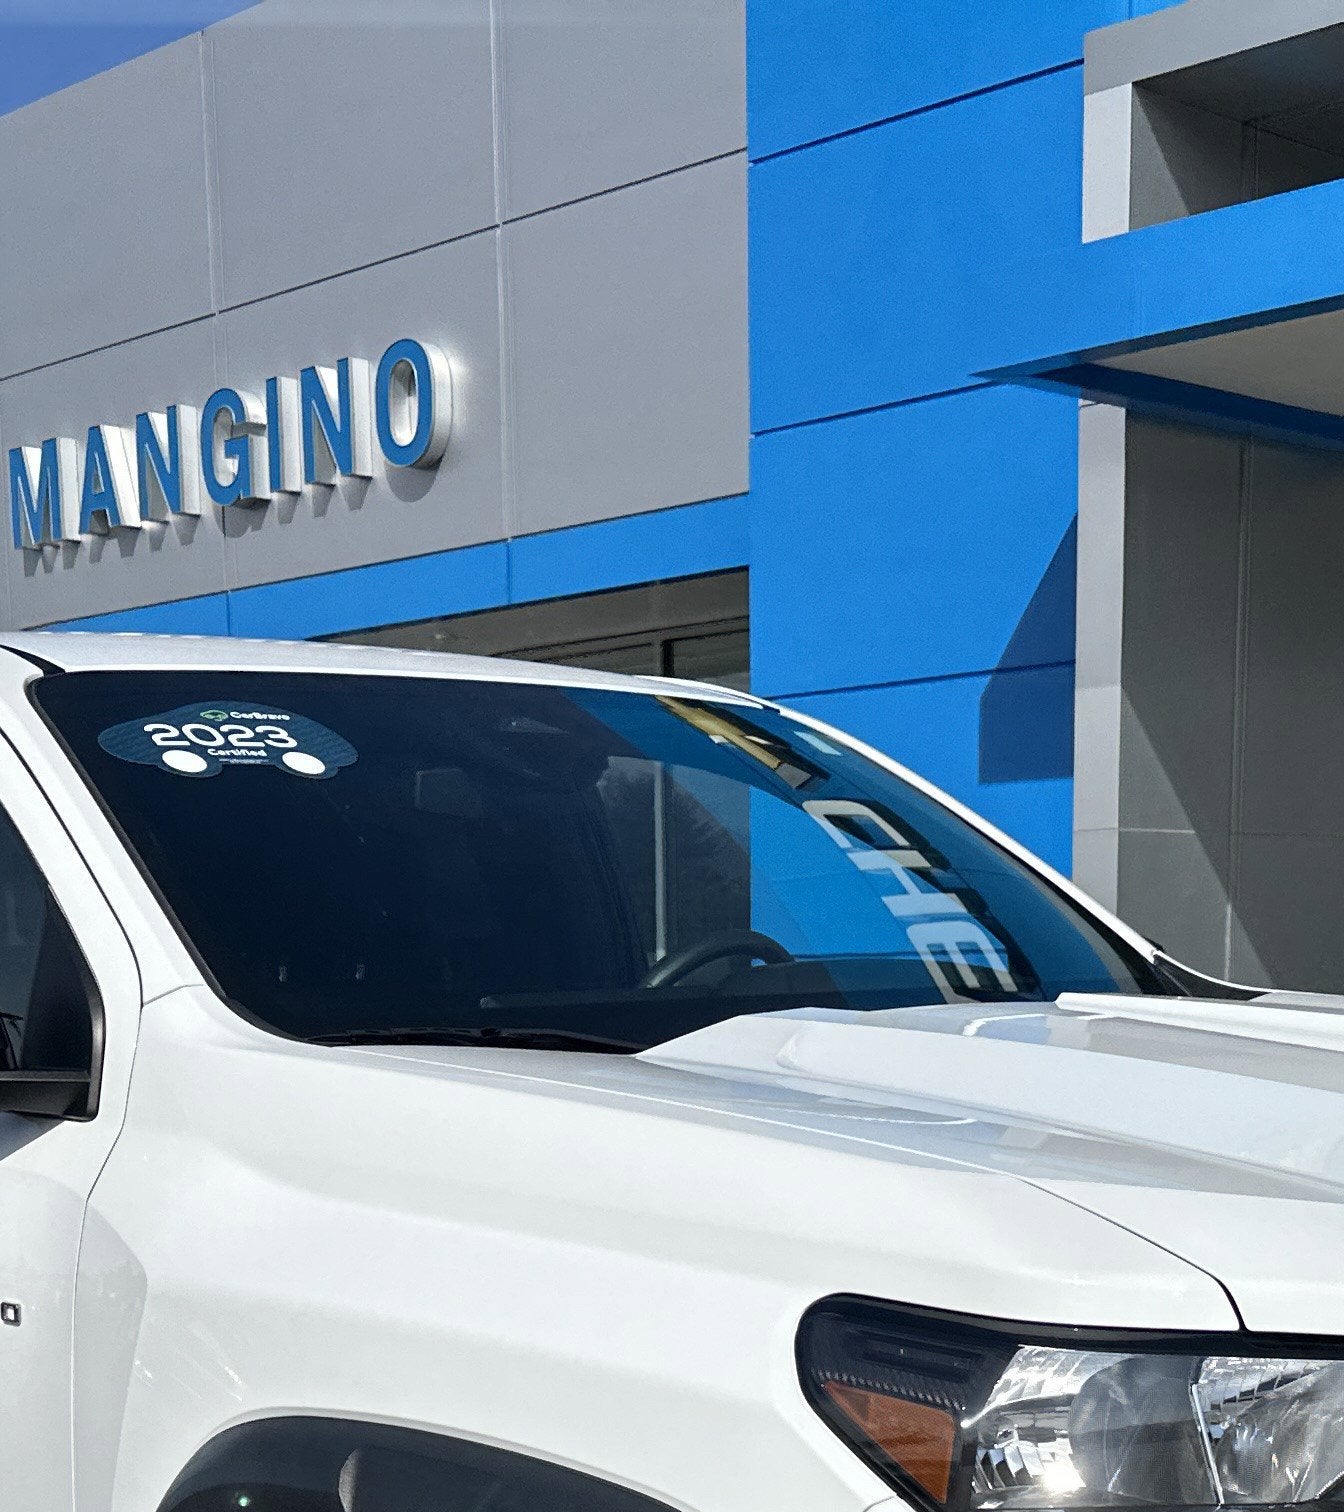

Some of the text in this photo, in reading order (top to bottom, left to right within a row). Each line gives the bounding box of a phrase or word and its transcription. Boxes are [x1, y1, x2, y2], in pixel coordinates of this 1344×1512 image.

[8, 338, 449, 550] MANGINO
[143, 723, 298, 748] 2023
[207, 748, 268, 757] Certified
